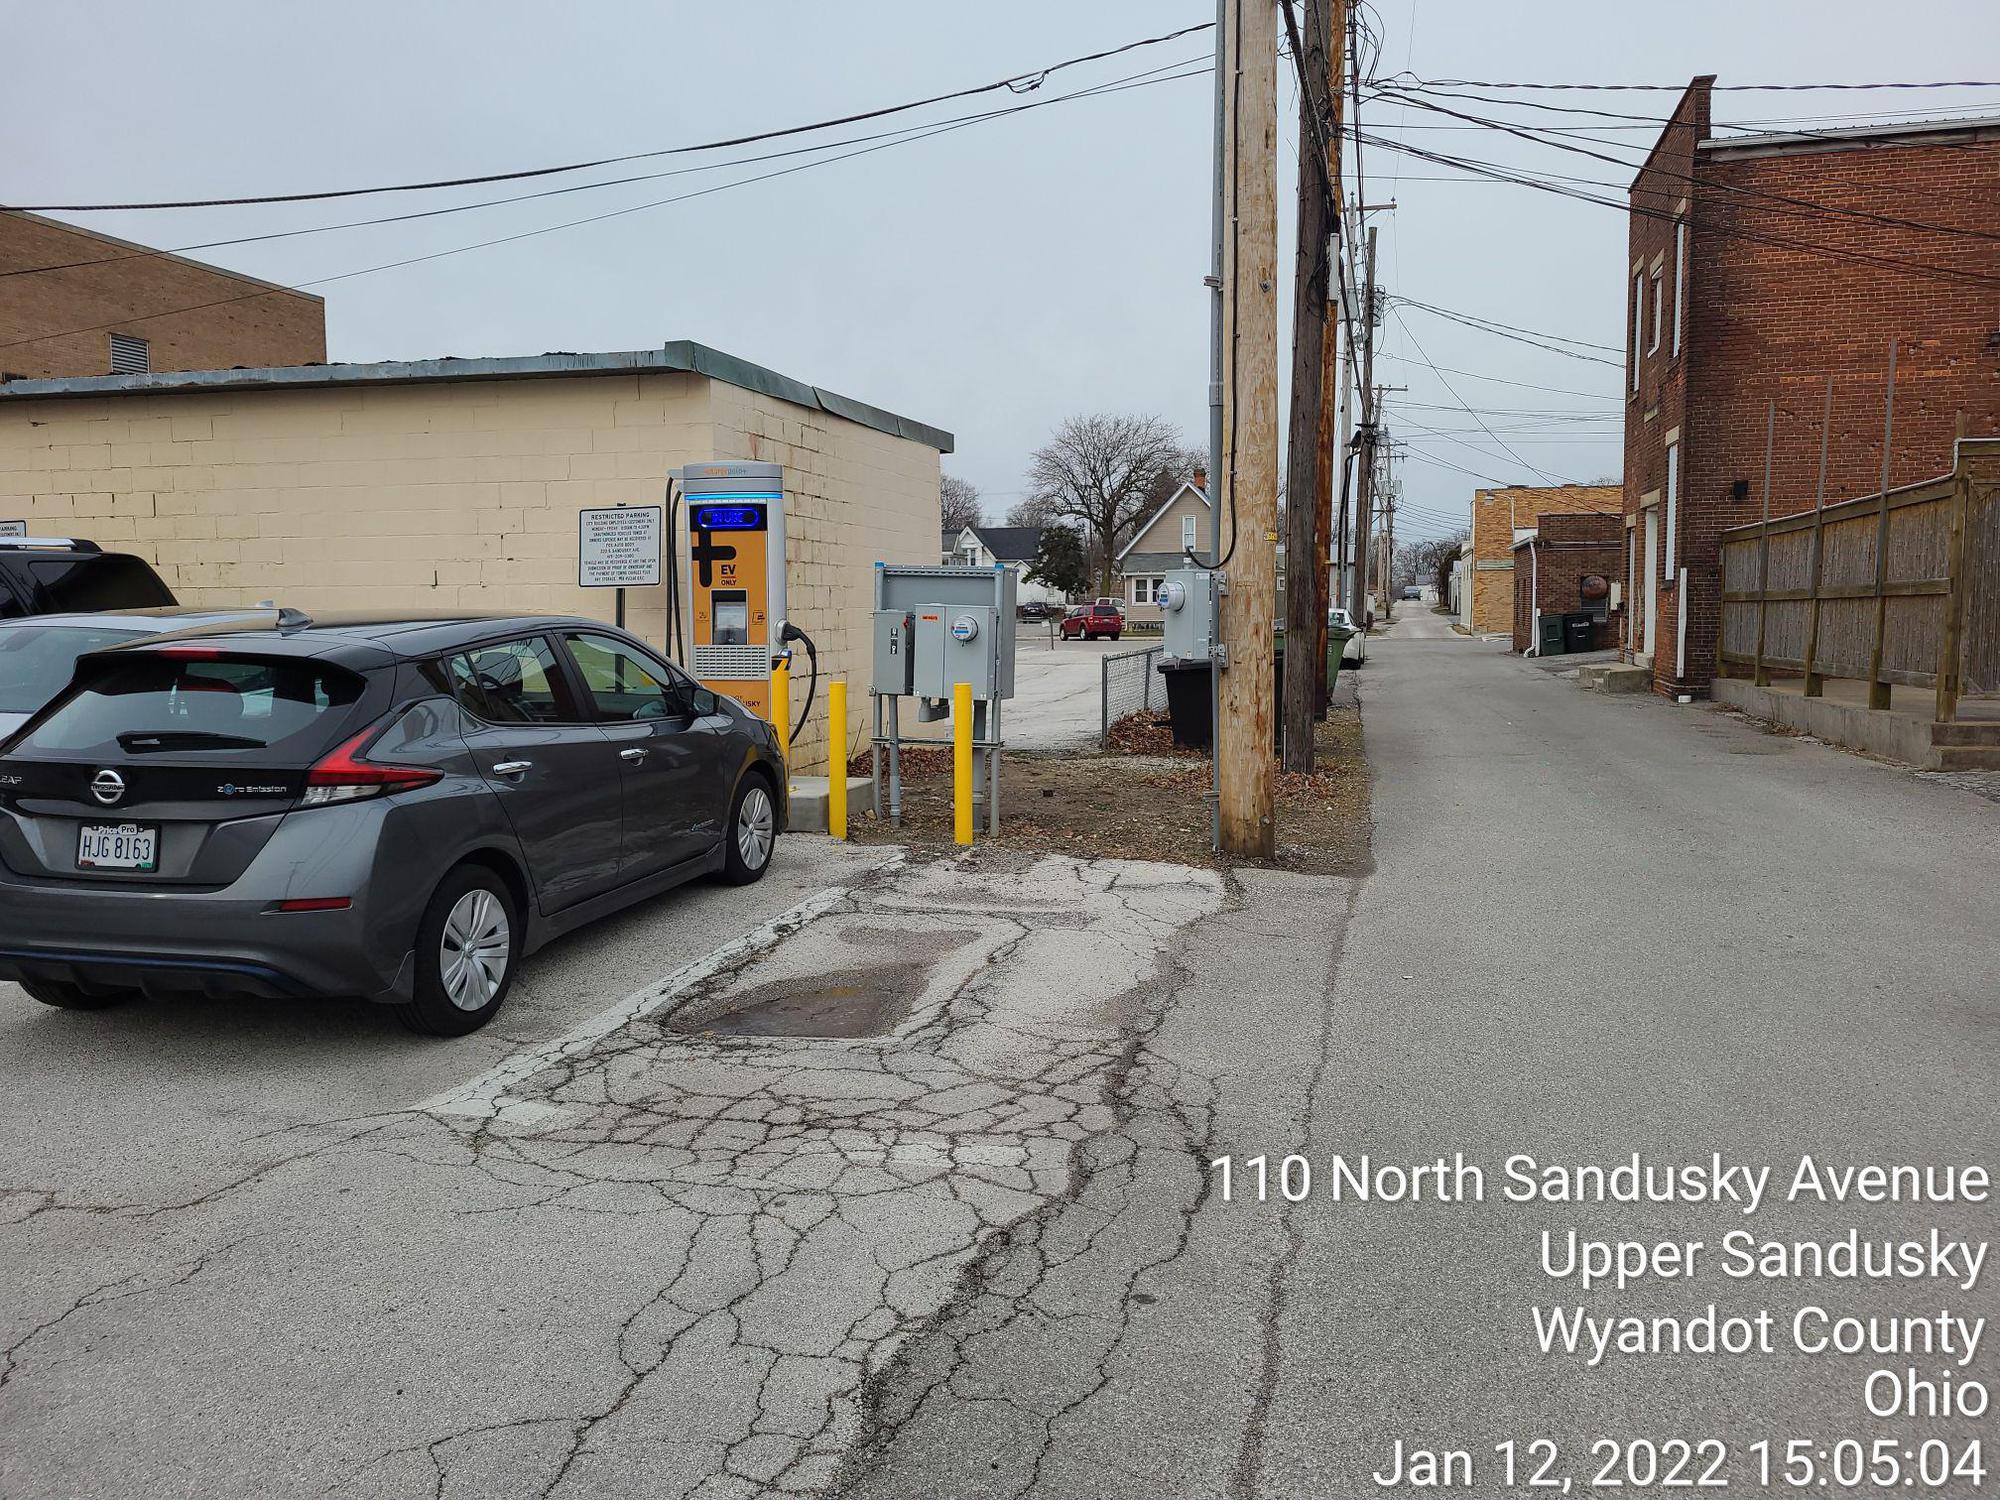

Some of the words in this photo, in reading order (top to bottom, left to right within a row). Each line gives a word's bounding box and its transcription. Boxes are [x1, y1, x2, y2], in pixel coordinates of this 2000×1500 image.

[721, 564, 736, 575] EV
[82, 835, 110, 858] HJG
[115, 837, 150, 860] 8163
